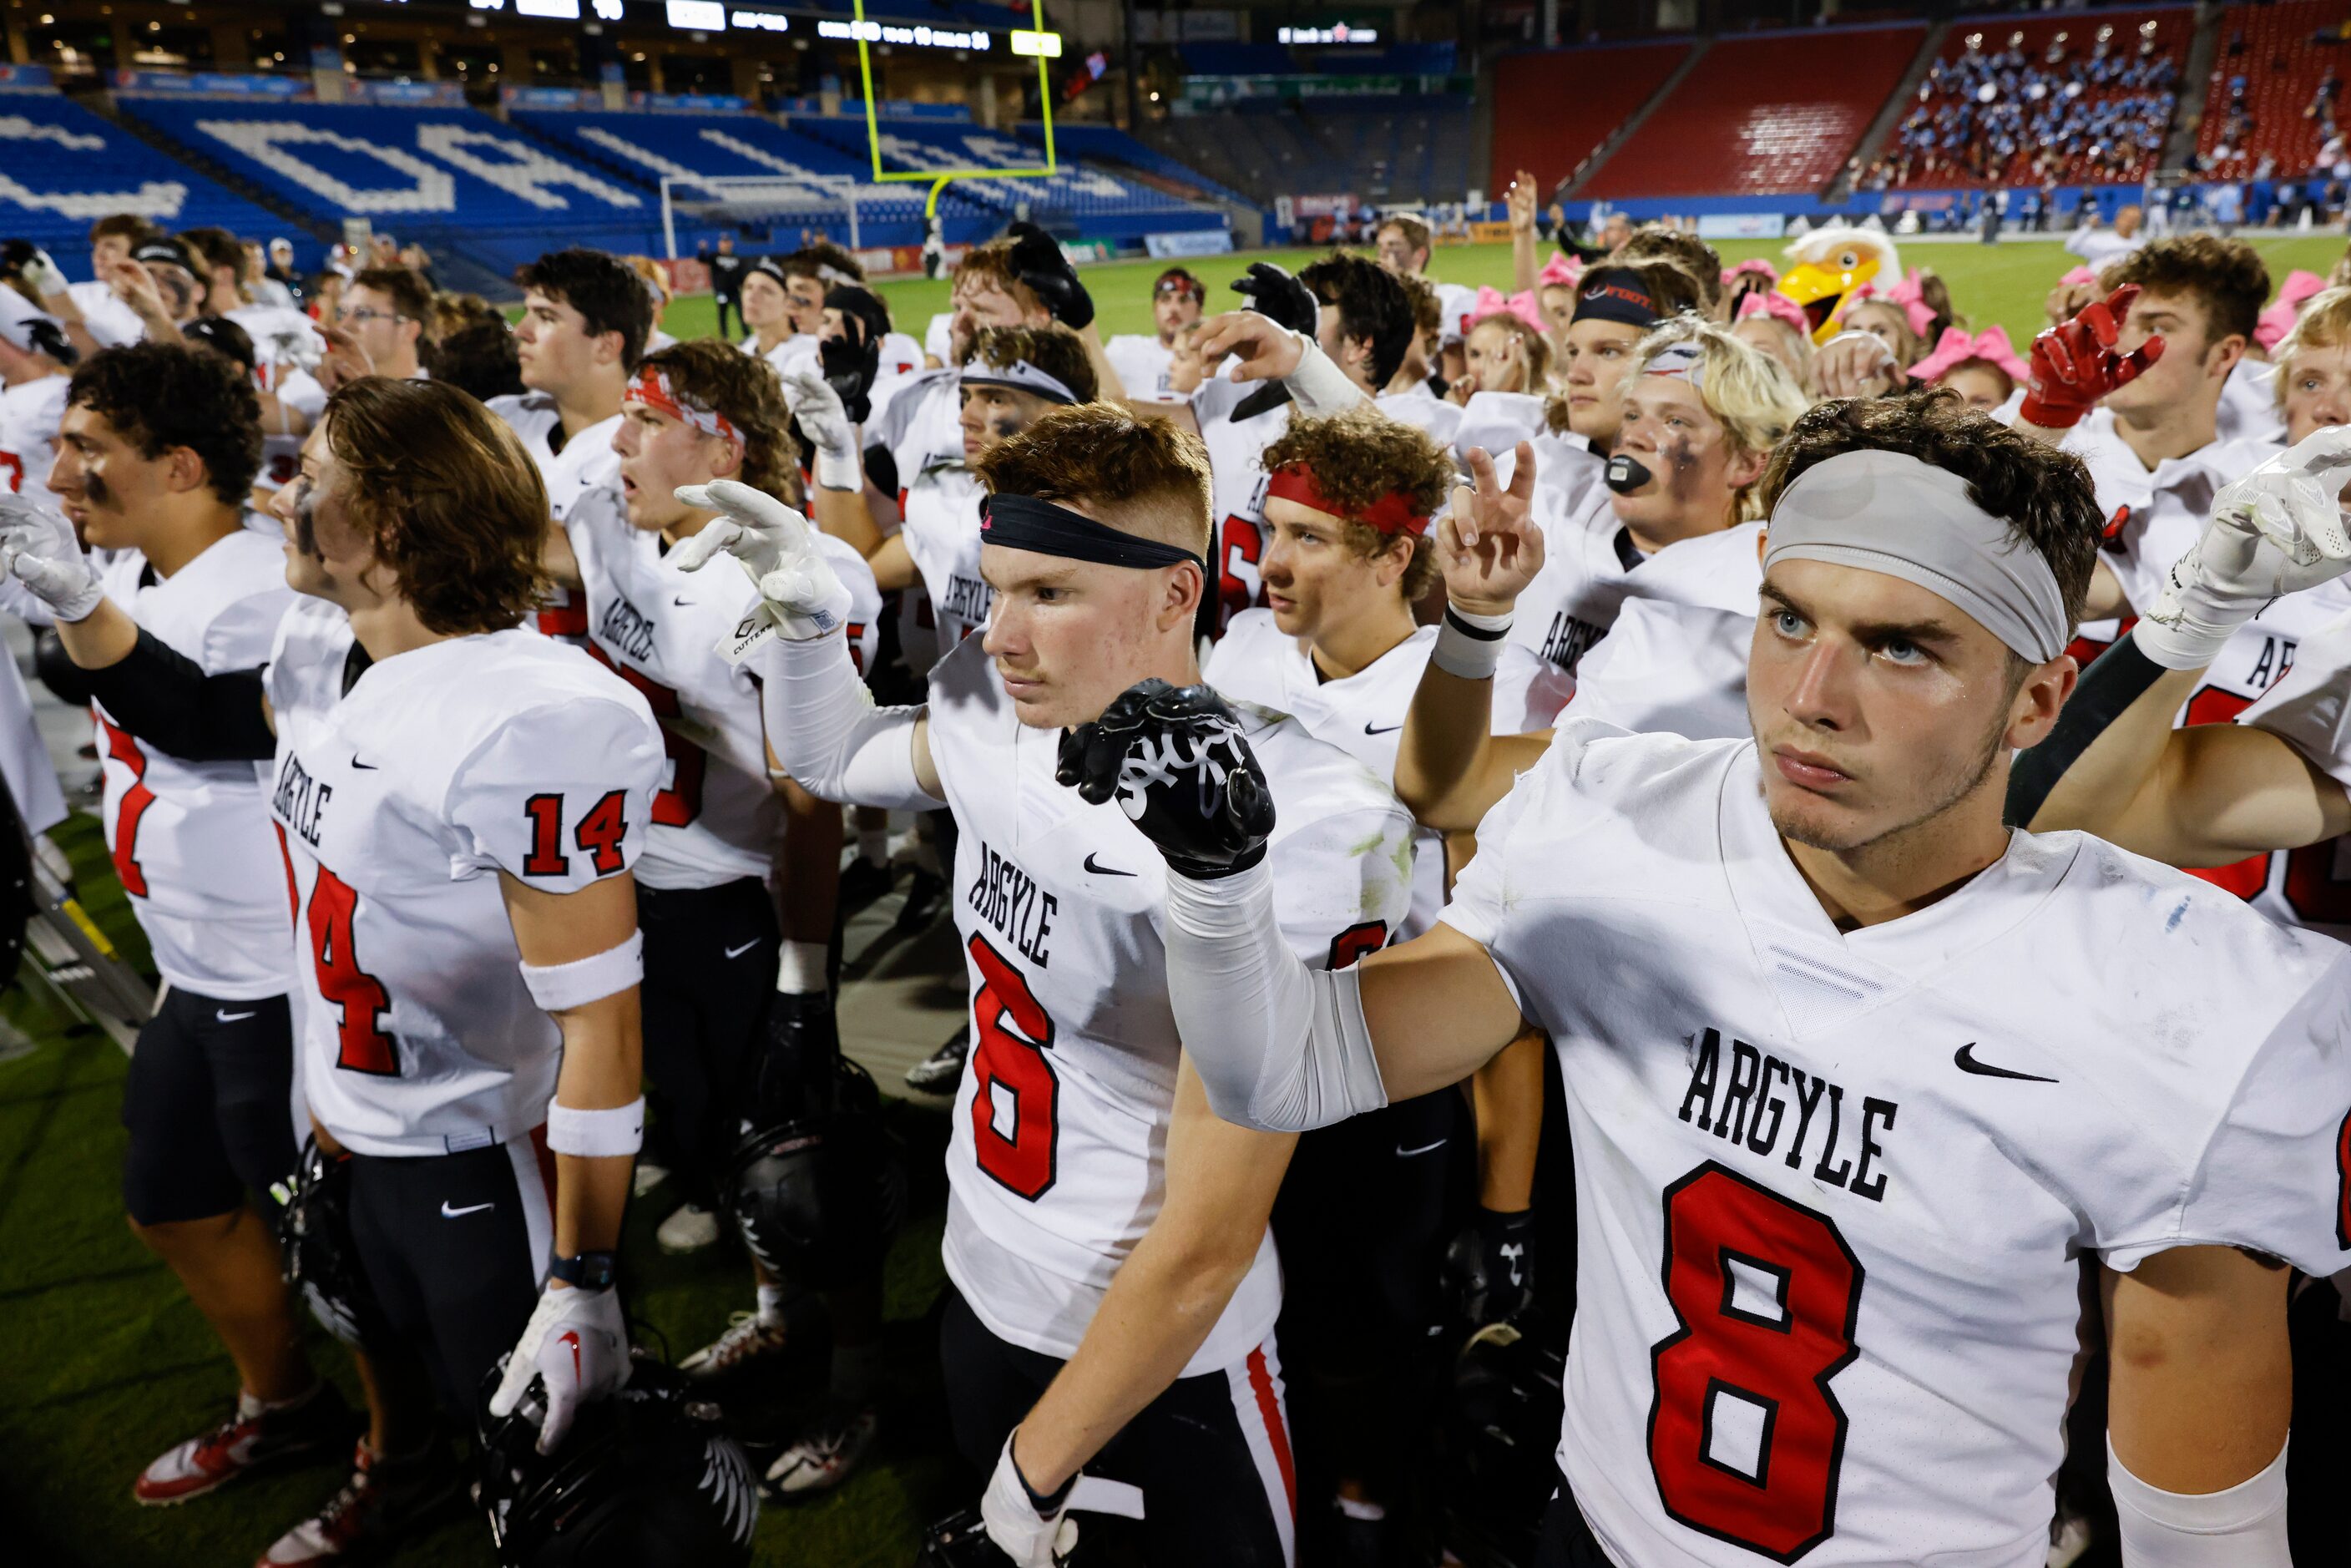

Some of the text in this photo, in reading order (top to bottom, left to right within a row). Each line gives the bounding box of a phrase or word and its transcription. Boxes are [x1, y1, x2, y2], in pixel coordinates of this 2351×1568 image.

[523, 788, 629, 877] 14
[968, 840, 1058, 969] ARGYLE
[967, 928, 1060, 1203] 6
[1677, 1026, 1898, 1202] ARGYLE
[1646, 1158, 1866, 1568] 8
